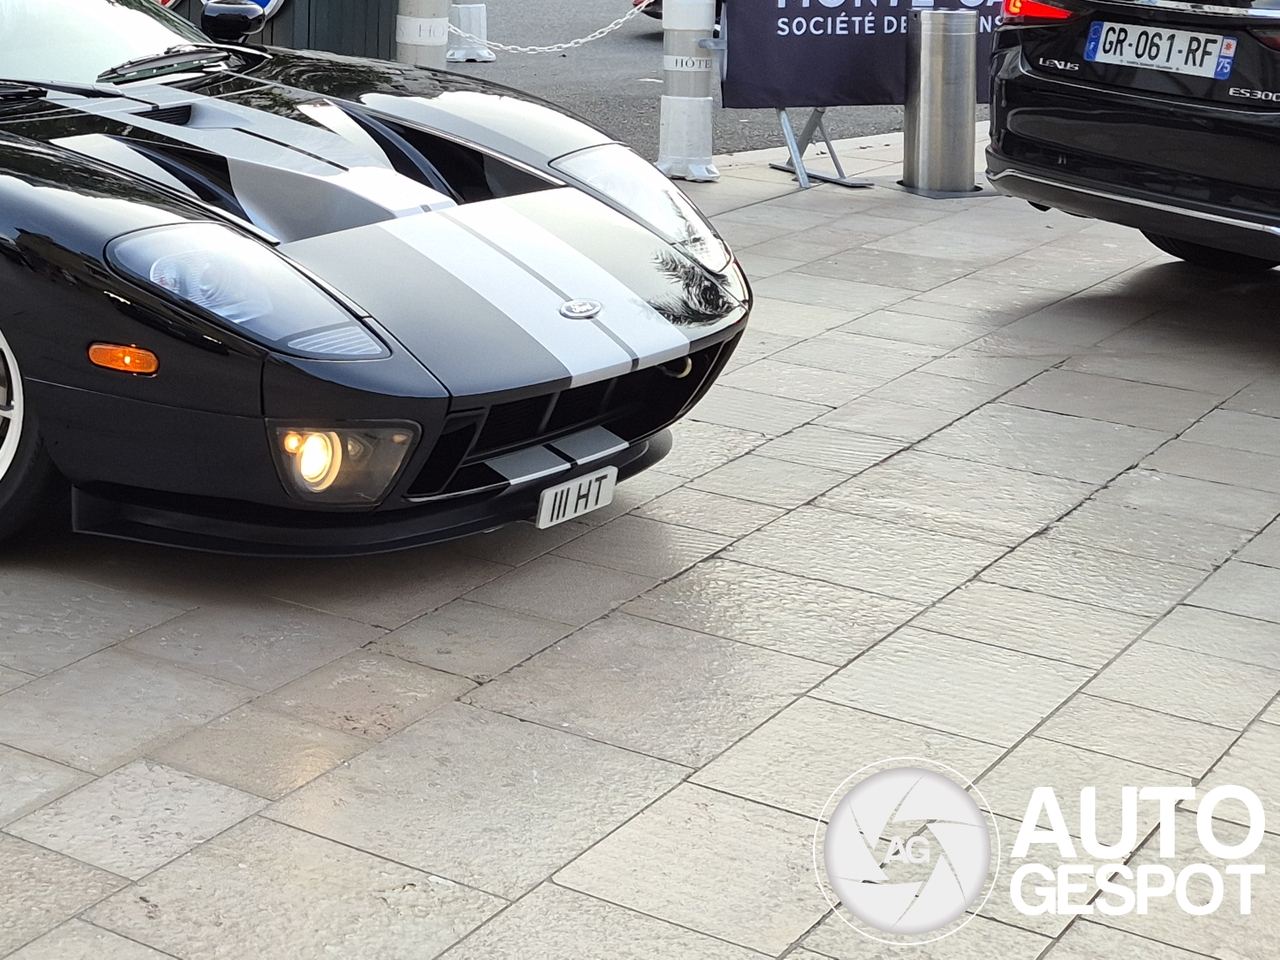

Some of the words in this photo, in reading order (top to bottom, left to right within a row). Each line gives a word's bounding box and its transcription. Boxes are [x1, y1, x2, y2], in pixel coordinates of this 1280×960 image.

[776, 11, 876, 36] SOCIÉTÉ
[1102, 26, 1218, 68] GR-061-RF
[1038, 57, 1080, 72] LEXUS
[1216, 58, 1231, 74] 75
[573, 473, 609, 514] HT
